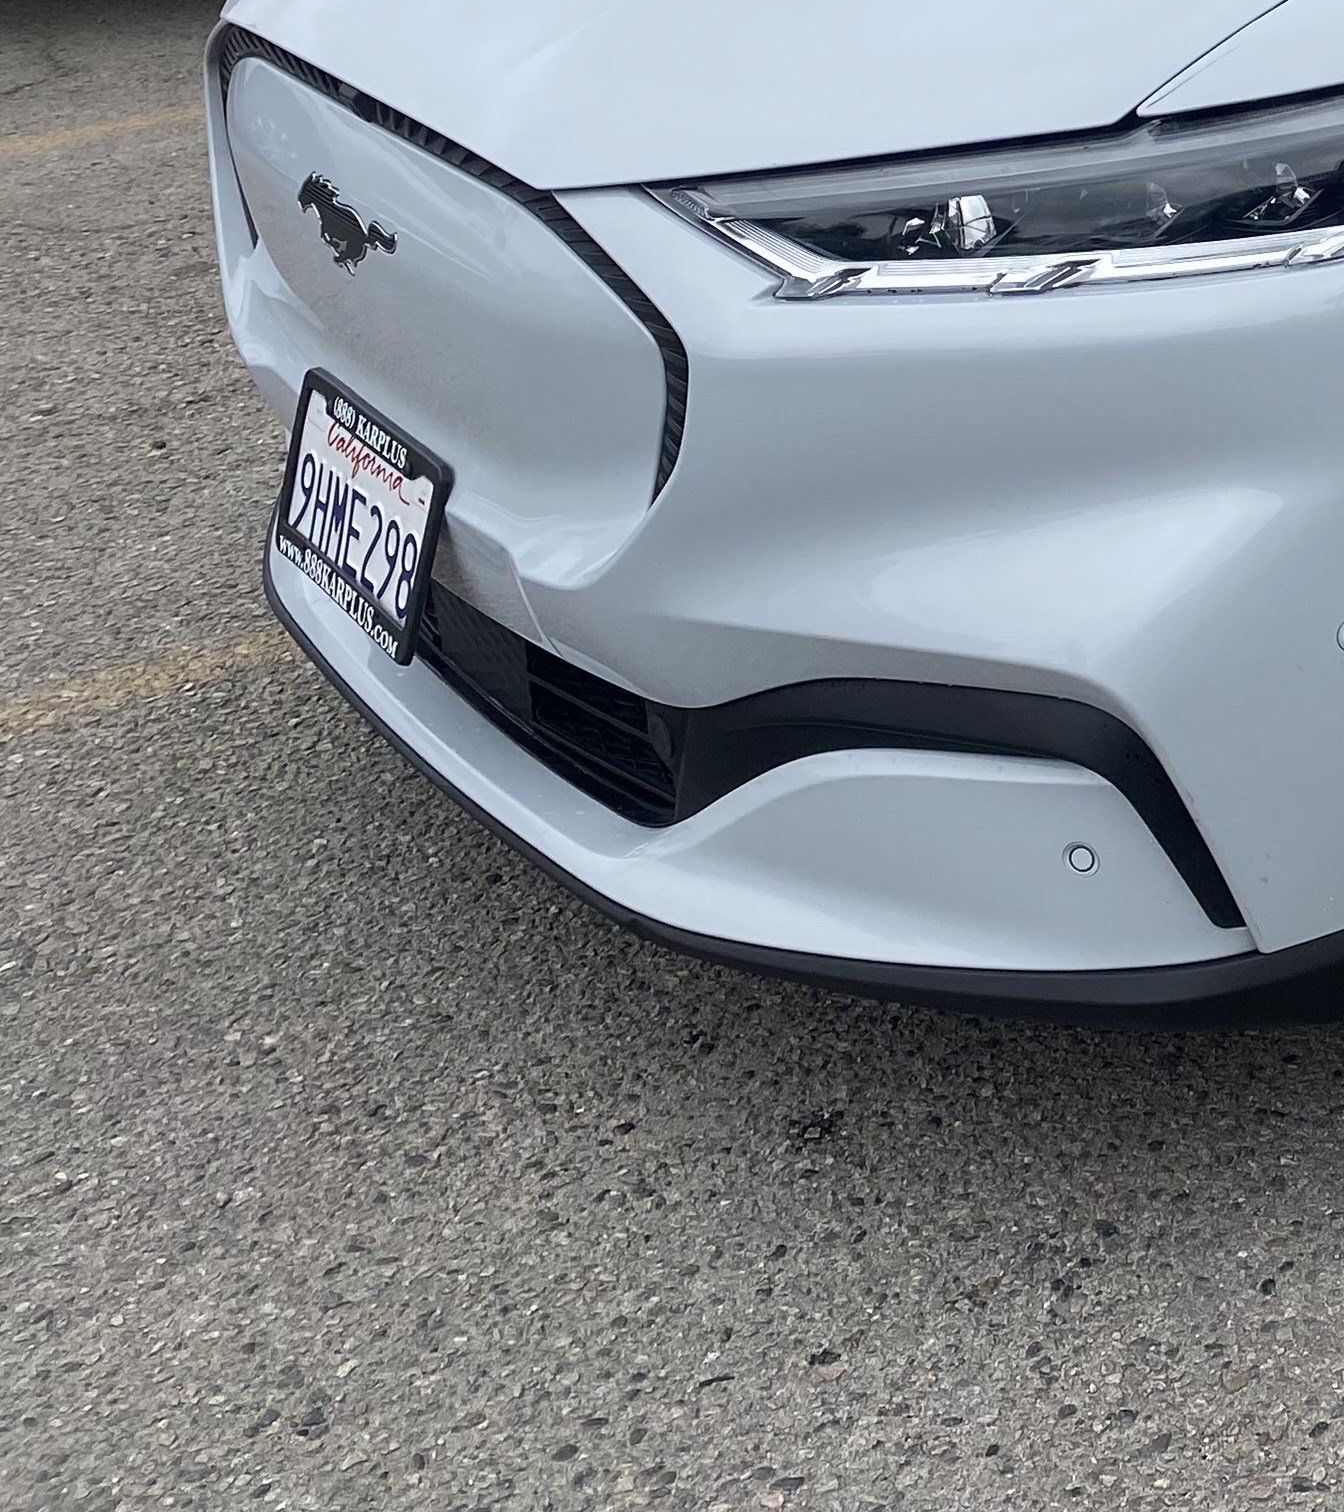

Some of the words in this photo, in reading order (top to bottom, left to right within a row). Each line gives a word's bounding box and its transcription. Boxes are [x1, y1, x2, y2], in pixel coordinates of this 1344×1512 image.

[327, 419, 411, 506] California
[333, 396, 357, 431] (888)
[356, 414, 408, 469] KARPLUS
[290, 452, 418, 619] 9HME298
